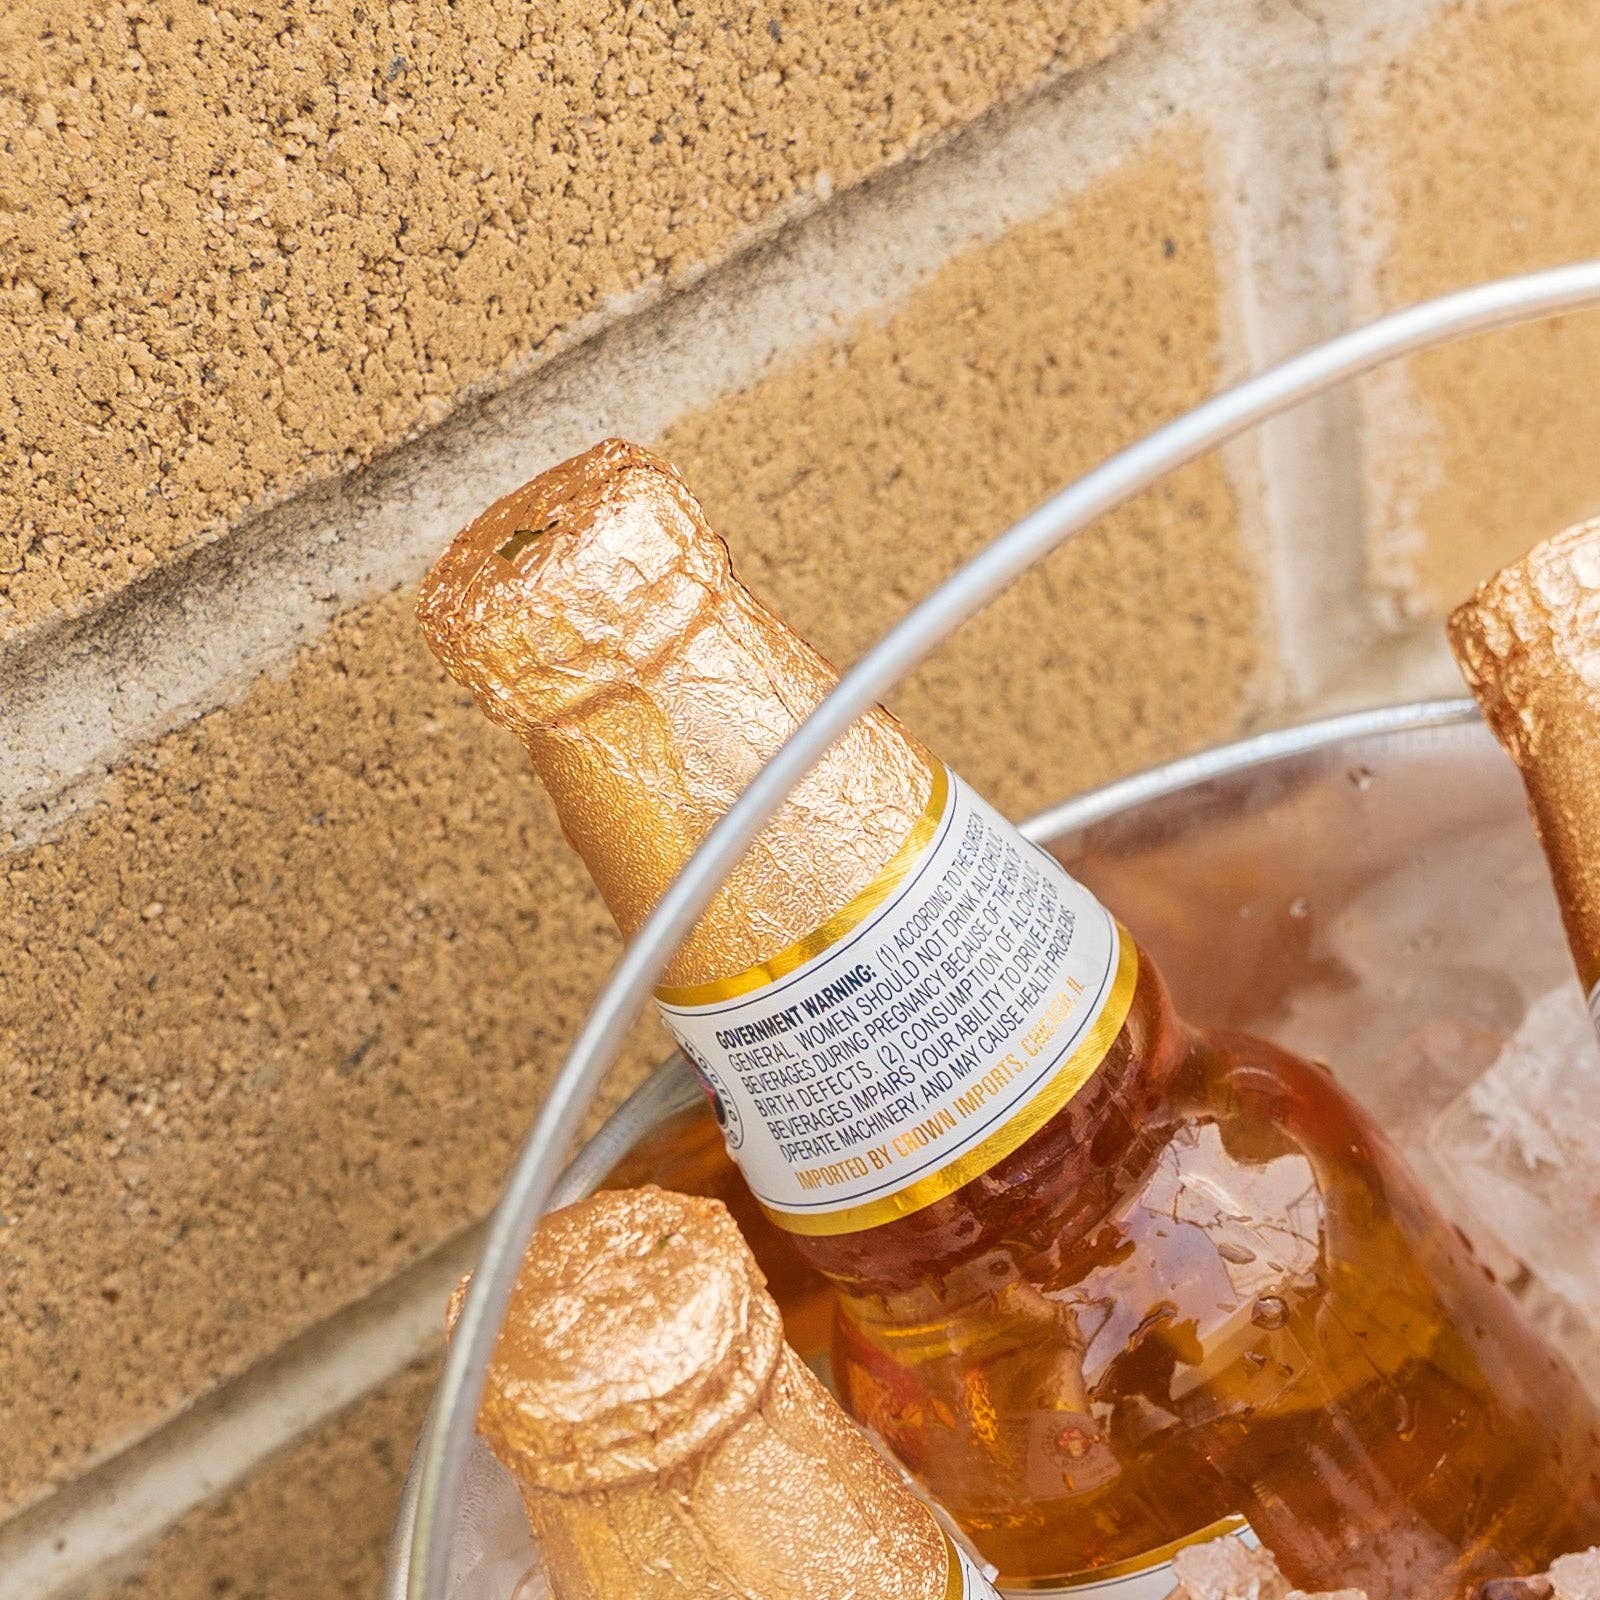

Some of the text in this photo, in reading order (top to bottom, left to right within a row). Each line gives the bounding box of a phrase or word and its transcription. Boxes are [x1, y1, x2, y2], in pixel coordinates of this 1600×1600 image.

[943, 870, 962, 892] TO
[952, 849, 975, 877] THE
[876, 943, 901, 972] (1)
[893, 885, 953, 954] ACCORDING
[728, 1041, 801, 1073] GENERAL,
[794, 1005, 861, 1052] WOMEN
[856, 959, 920, 1016] SHOULD
[915, 929, 950, 968] NOT
[942, 889, 981, 938] DRINK
[740, 1060, 817, 1095] BEVERAGES
[812, 1031, 870, 1074] DURING
[864, 968, 947, 1044] PREGNANCY
[940, 918, 993, 981] BECAUSE
[982, 900, 1002, 926] OF
[992, 878, 1014, 908] THE
[800, 964, 878, 1019] WARNING:
[715, 1005, 804, 1050] GOVERNMENT
[753, 1092, 801, 1119] BIRTH
[797, 1060, 879, 1109] DEFECTS.
[876, 1041, 905, 1072] (2)
[900, 947, 1004, 1050] CONSUMPTION
[995, 926, 1016, 953] OF
[767, 1100, 854, 1141] BEVERAGES
[851, 1064, 917, 1114] IMPAIRS
[909, 1031, 961, 1074] YOUR
[955, 983, 1006, 1042] ABILITY
[998, 966, 1021, 992] TO
[1012, 926, 1048, 973] DRIVE
[779, 1132, 841, 1164] OPERATE
[836, 1092, 926, 1148] MACHINERY,
[920, 1070, 954, 1105] AND
[948, 1044, 981, 1081] MAY
[978, 1004, 1025, 1055] CAUSE
[1014, 959, 1058, 1015] HEALTH
[794, 1156, 870, 1192] IMPORTED
[867, 1144, 893, 1171] BY
[892, 1107, 959, 1158] CROWN
